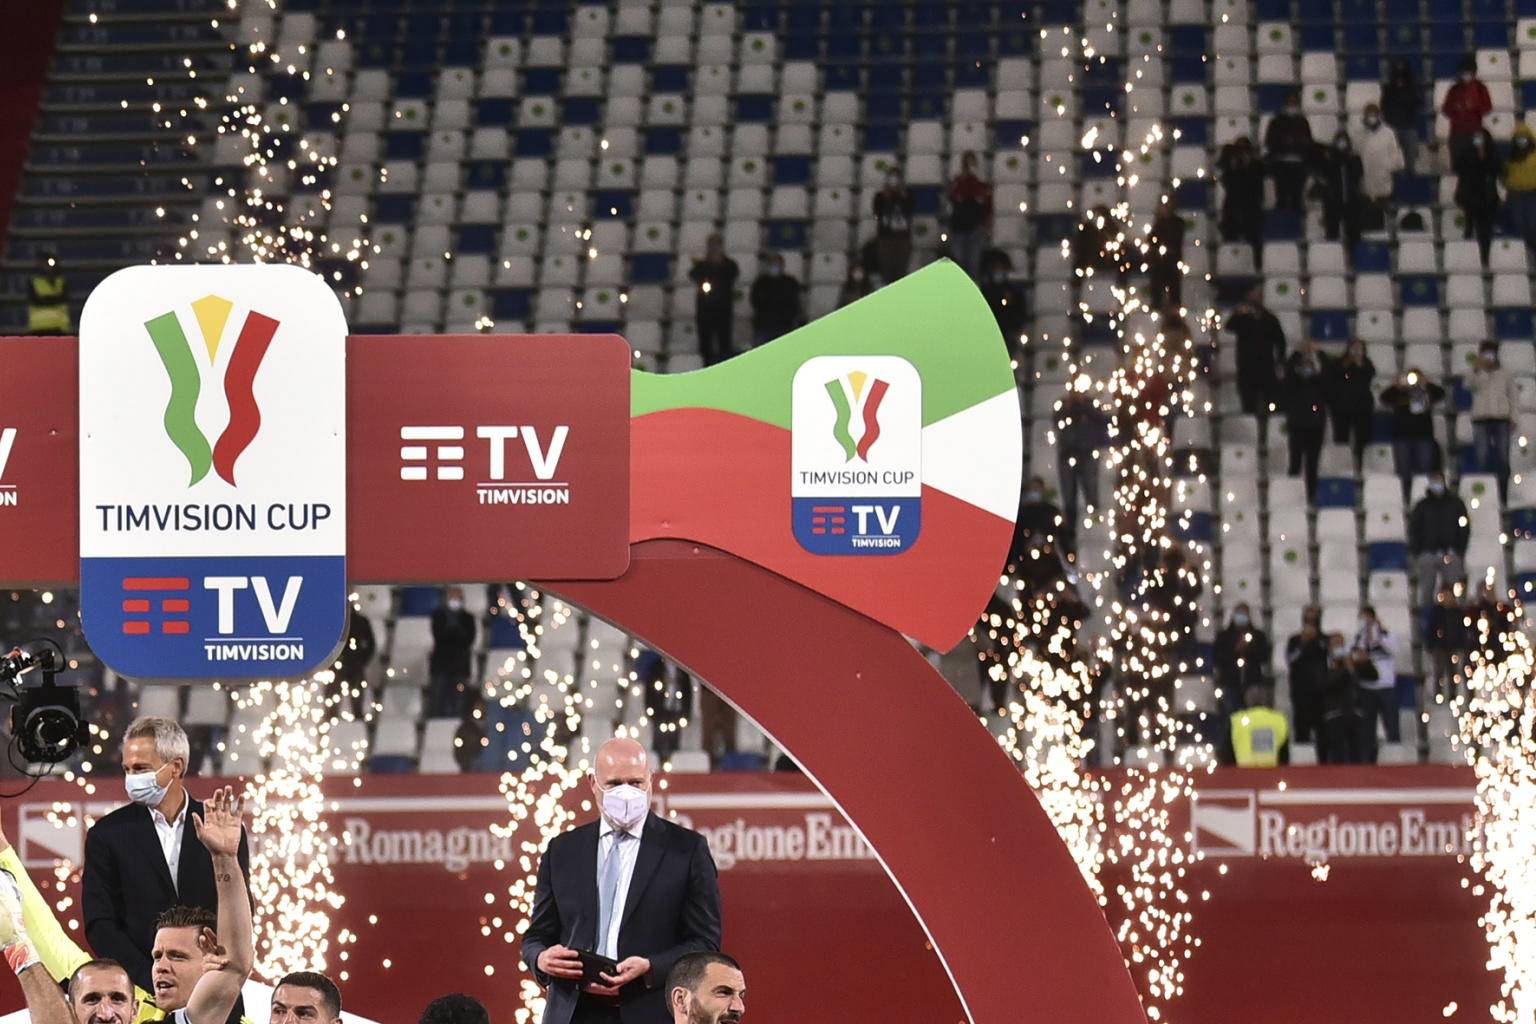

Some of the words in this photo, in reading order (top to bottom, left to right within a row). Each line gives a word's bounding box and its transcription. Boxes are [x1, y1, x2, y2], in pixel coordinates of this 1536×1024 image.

[477, 426, 569, 480] TV
[800, 471, 878, 485] TIMVISION
[883, 470, 914, 485] CUP
[477, 489, 569, 504] TIMVISION
[95, 504, 257, 531] TIMVISION
[267, 503, 331, 531] CUP
[852, 505, 900, 535] TV
[852, 538, 901, 547] TIMVISION
[204, 576, 303, 634] TV
[205, 645, 303, 660] TIMVISION
